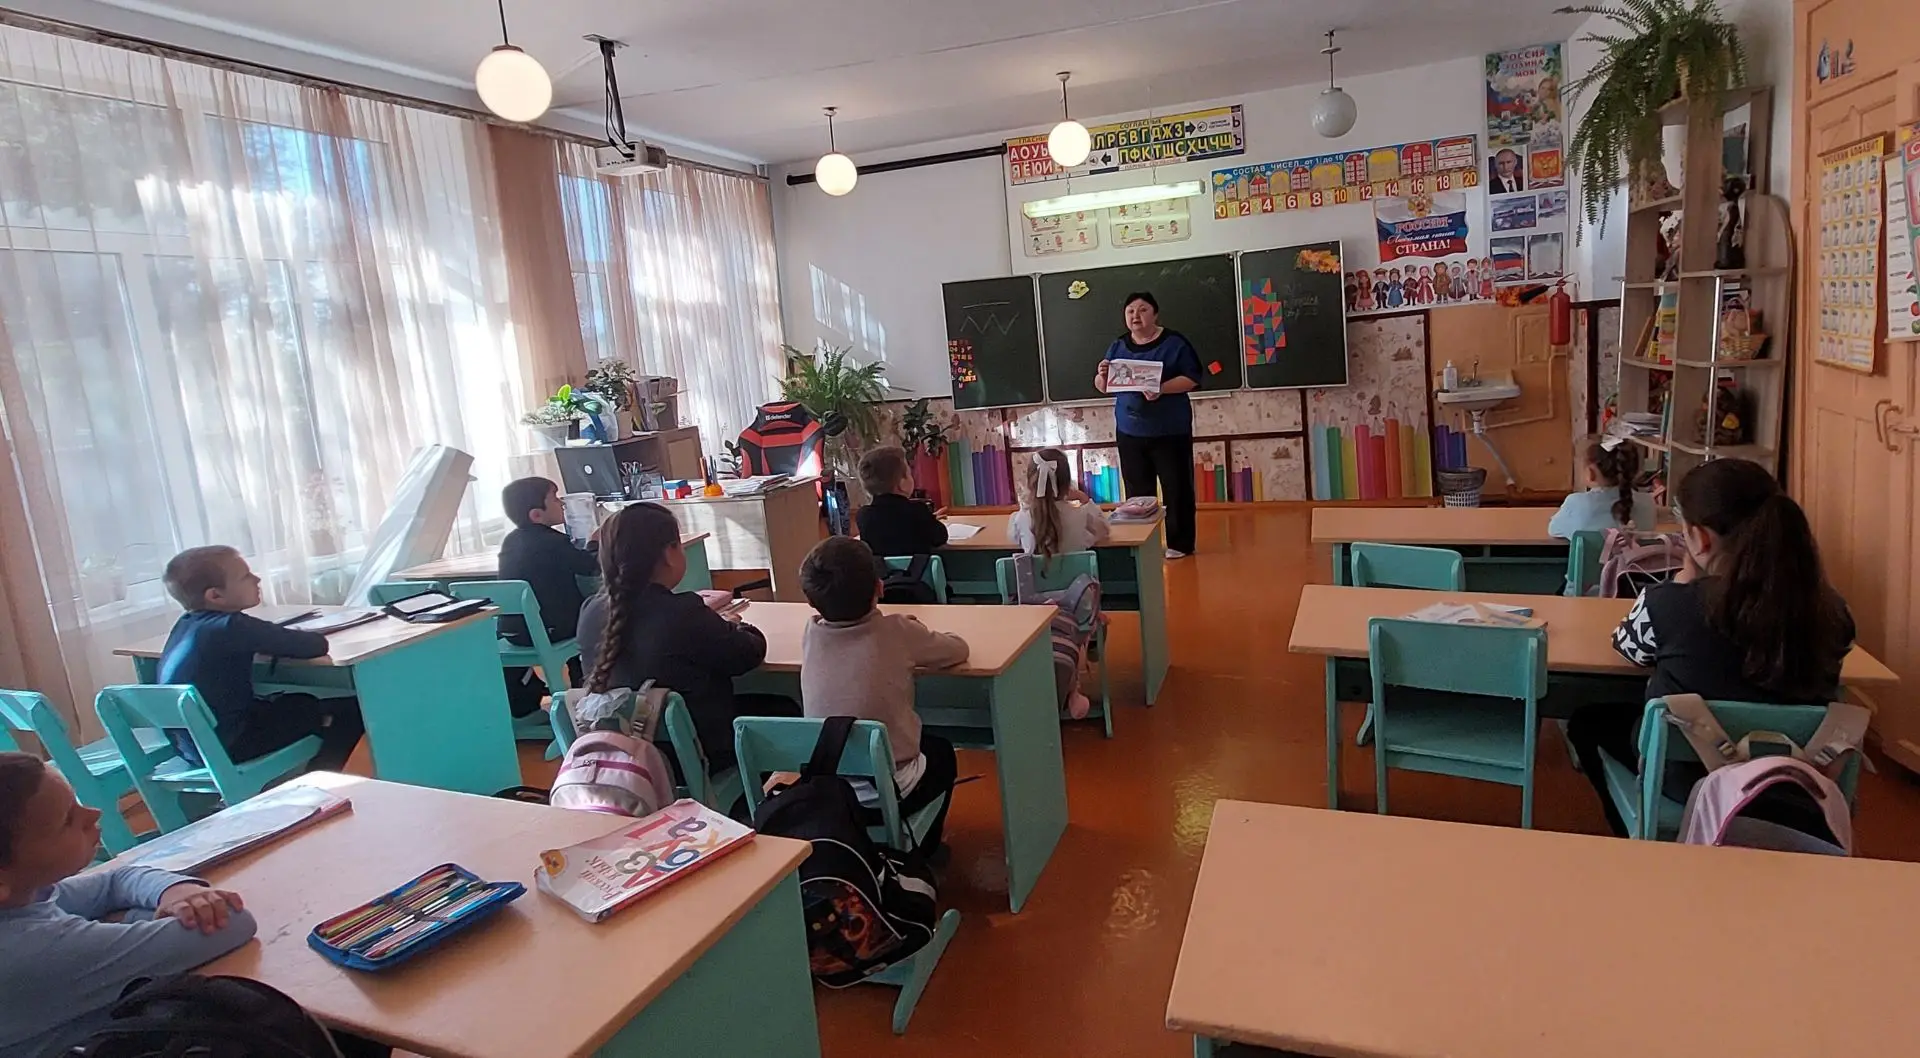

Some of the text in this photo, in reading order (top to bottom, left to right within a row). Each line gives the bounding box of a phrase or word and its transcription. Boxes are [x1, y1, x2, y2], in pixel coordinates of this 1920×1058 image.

[1232, 165, 1266, 176] СОСТАВ
[1270, 160, 1300, 169] ЧИСЕЛ
[1240, 202, 1250, 215] 2
[1262, 198, 1272, 212] 4
[1287, 195, 1297, 208] 6
[1312, 192, 1322, 205] 8
[1335, 189, 1346, 203] 10
[1360, 186, 1372, 199] 12
[1386, 183, 1398, 196] 14
[1412, 179, 1424, 193] 16
[1437, 175, 1450, 190] 18
[1463, 171, 1476, 186] 20
[1395, 239, 1451, 255] СТРАНА!
[579, 870, 625, 900] Русский
